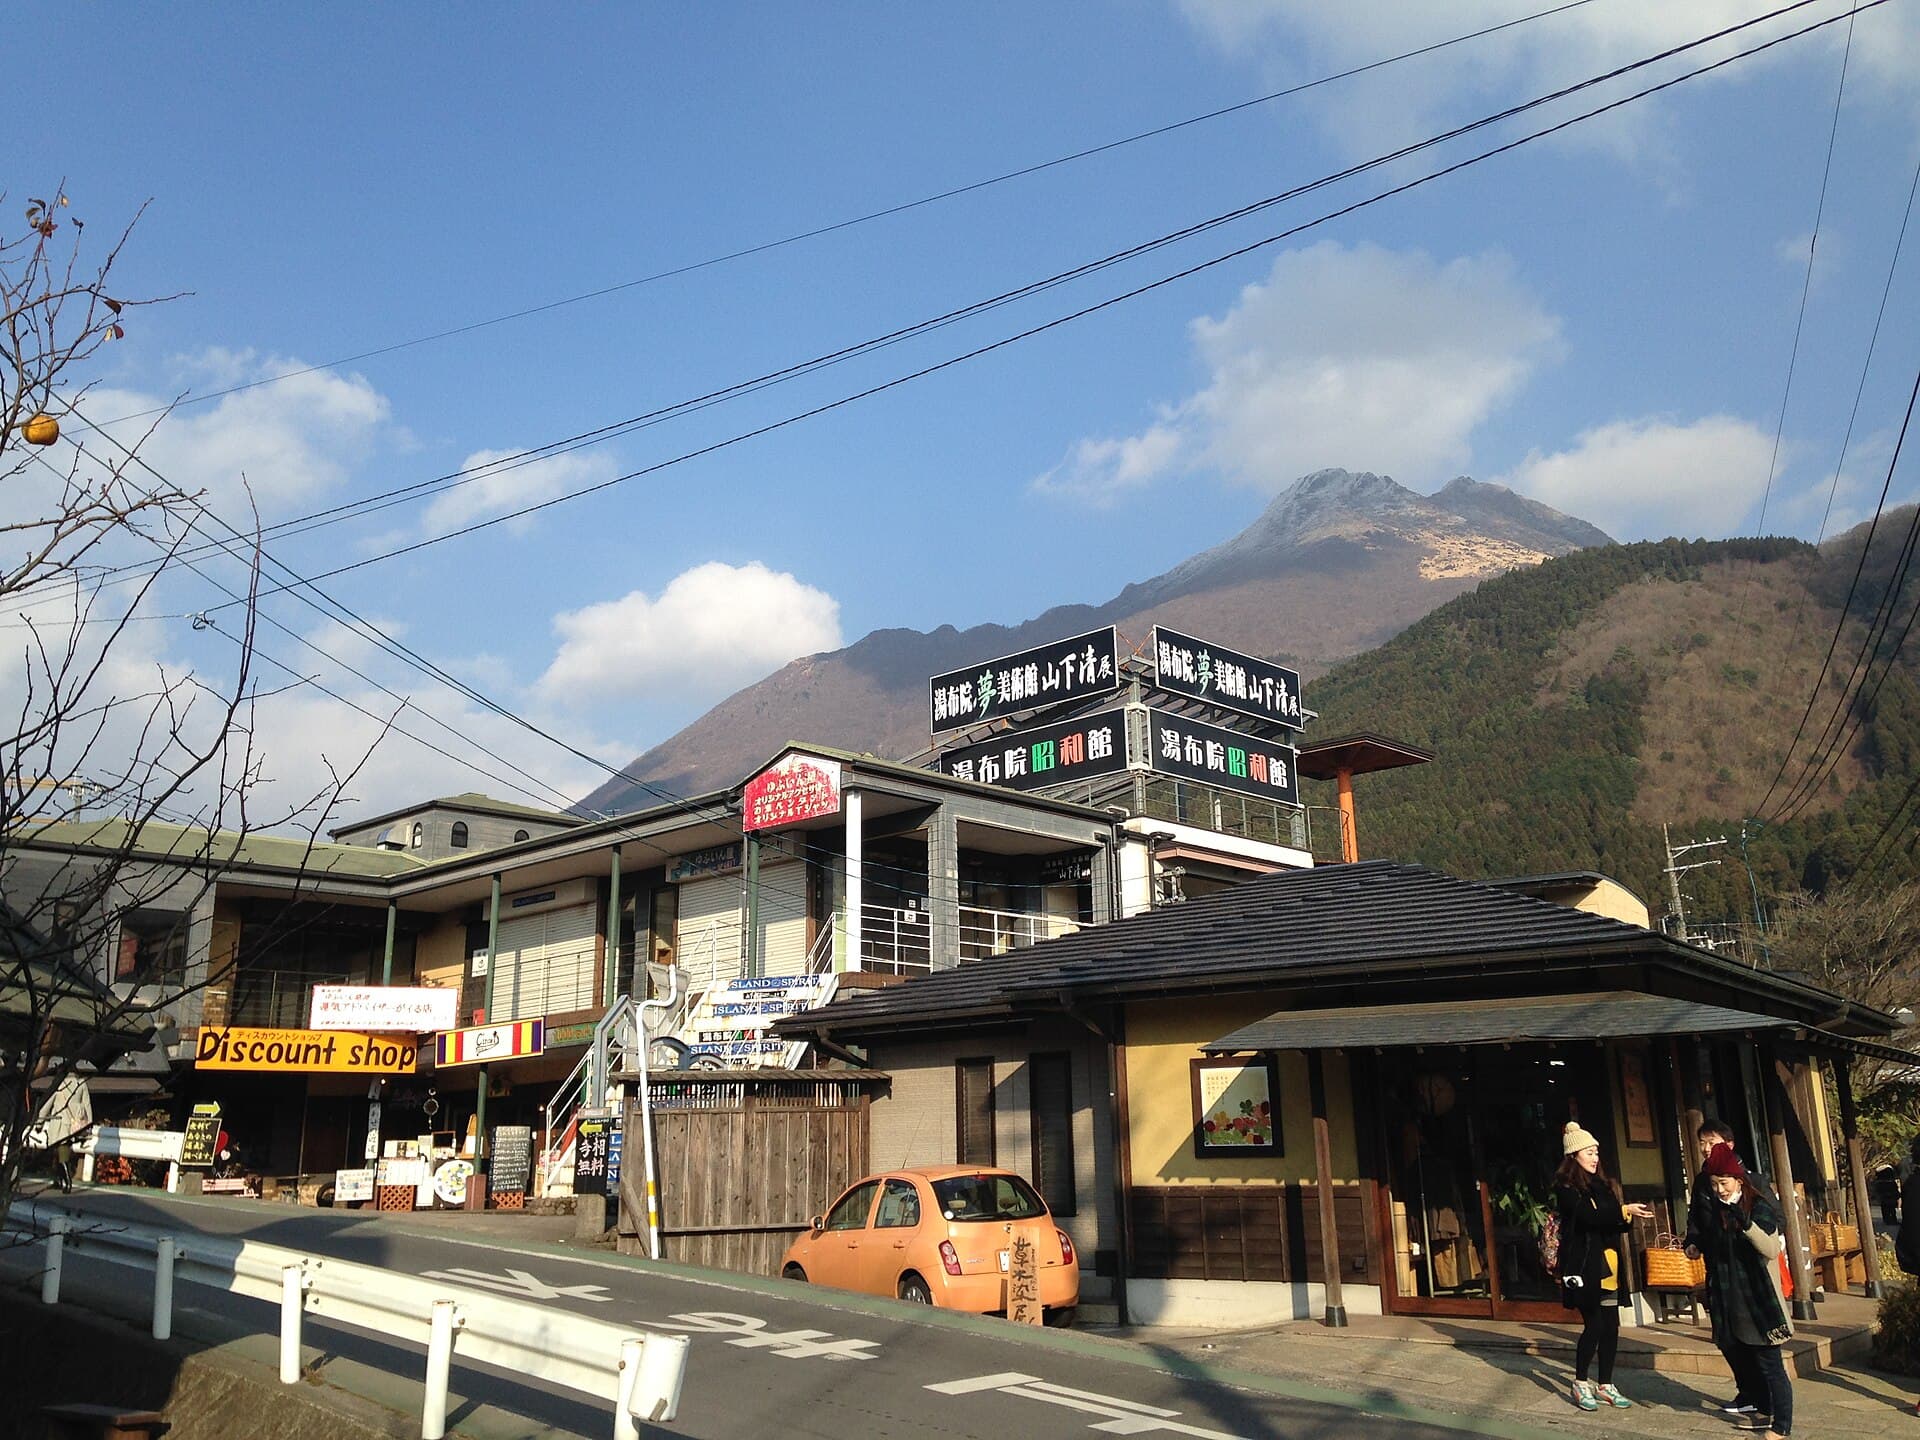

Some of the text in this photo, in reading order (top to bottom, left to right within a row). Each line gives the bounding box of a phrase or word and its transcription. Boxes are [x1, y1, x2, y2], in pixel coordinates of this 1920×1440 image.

[951, 726, 1113, 783] 湯布院昭和館
[1160, 727, 1288, 788] 湯布院昭和館
[731, 979, 771, 989] SLAND
[196, 1031, 416, 1070] Discount shop
[577, 1157, 605, 1177] 無料
